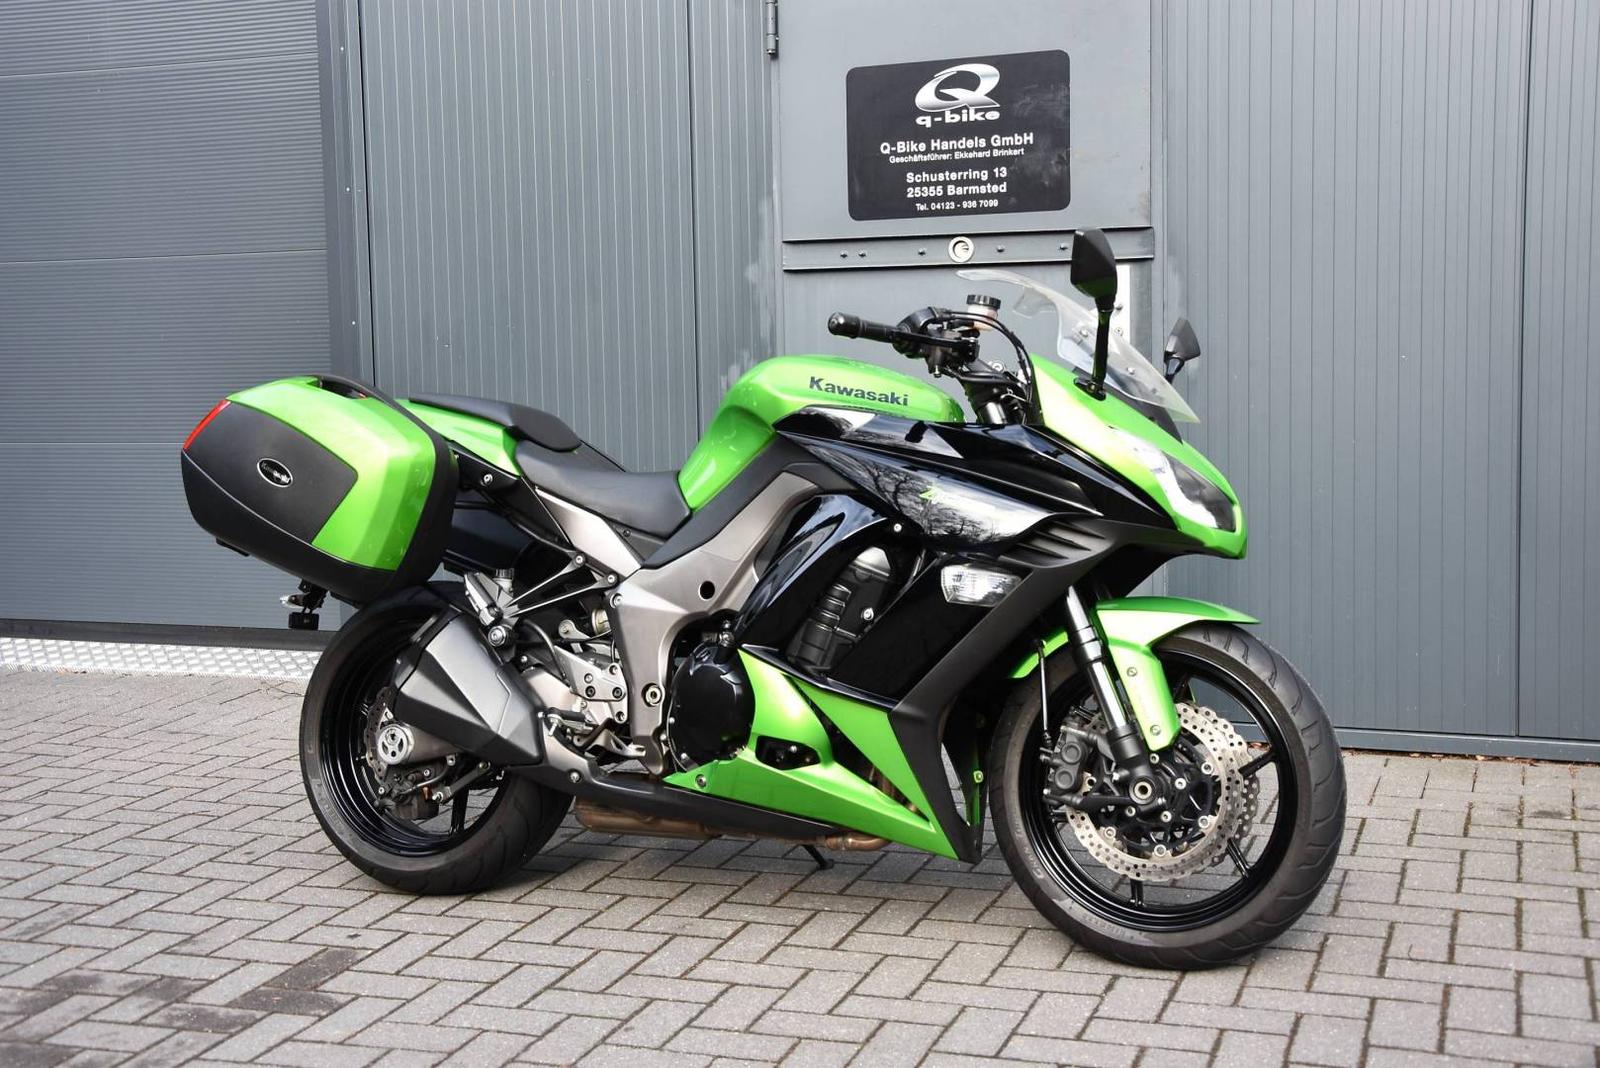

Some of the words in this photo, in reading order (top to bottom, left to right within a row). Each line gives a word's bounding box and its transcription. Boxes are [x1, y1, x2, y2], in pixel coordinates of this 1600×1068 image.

[915, 107, 1000, 128] q-bike
[880, 140, 927, 155] Q-Bike
[931, 136, 986, 151] Handels
[991, 132, 1034, 146] GmbH
[889, 153, 952, 164] Geschäftsführer:
[954, 150, 991, 160] Ekkehard
[993, 147, 1025, 157] Brinkert
[906, 168, 988, 183] Schusterring
[994, 167, 1007, 177] 13
[907, 186, 943, 198] 25355
[947, 182, 1007, 195] Barmsted
[916, 202, 929, 211] Tel.
[931, 201, 955, 210] 04123
[979, 199, 999, 208] 7099
[809, 376, 909, 406] Kawasaki
